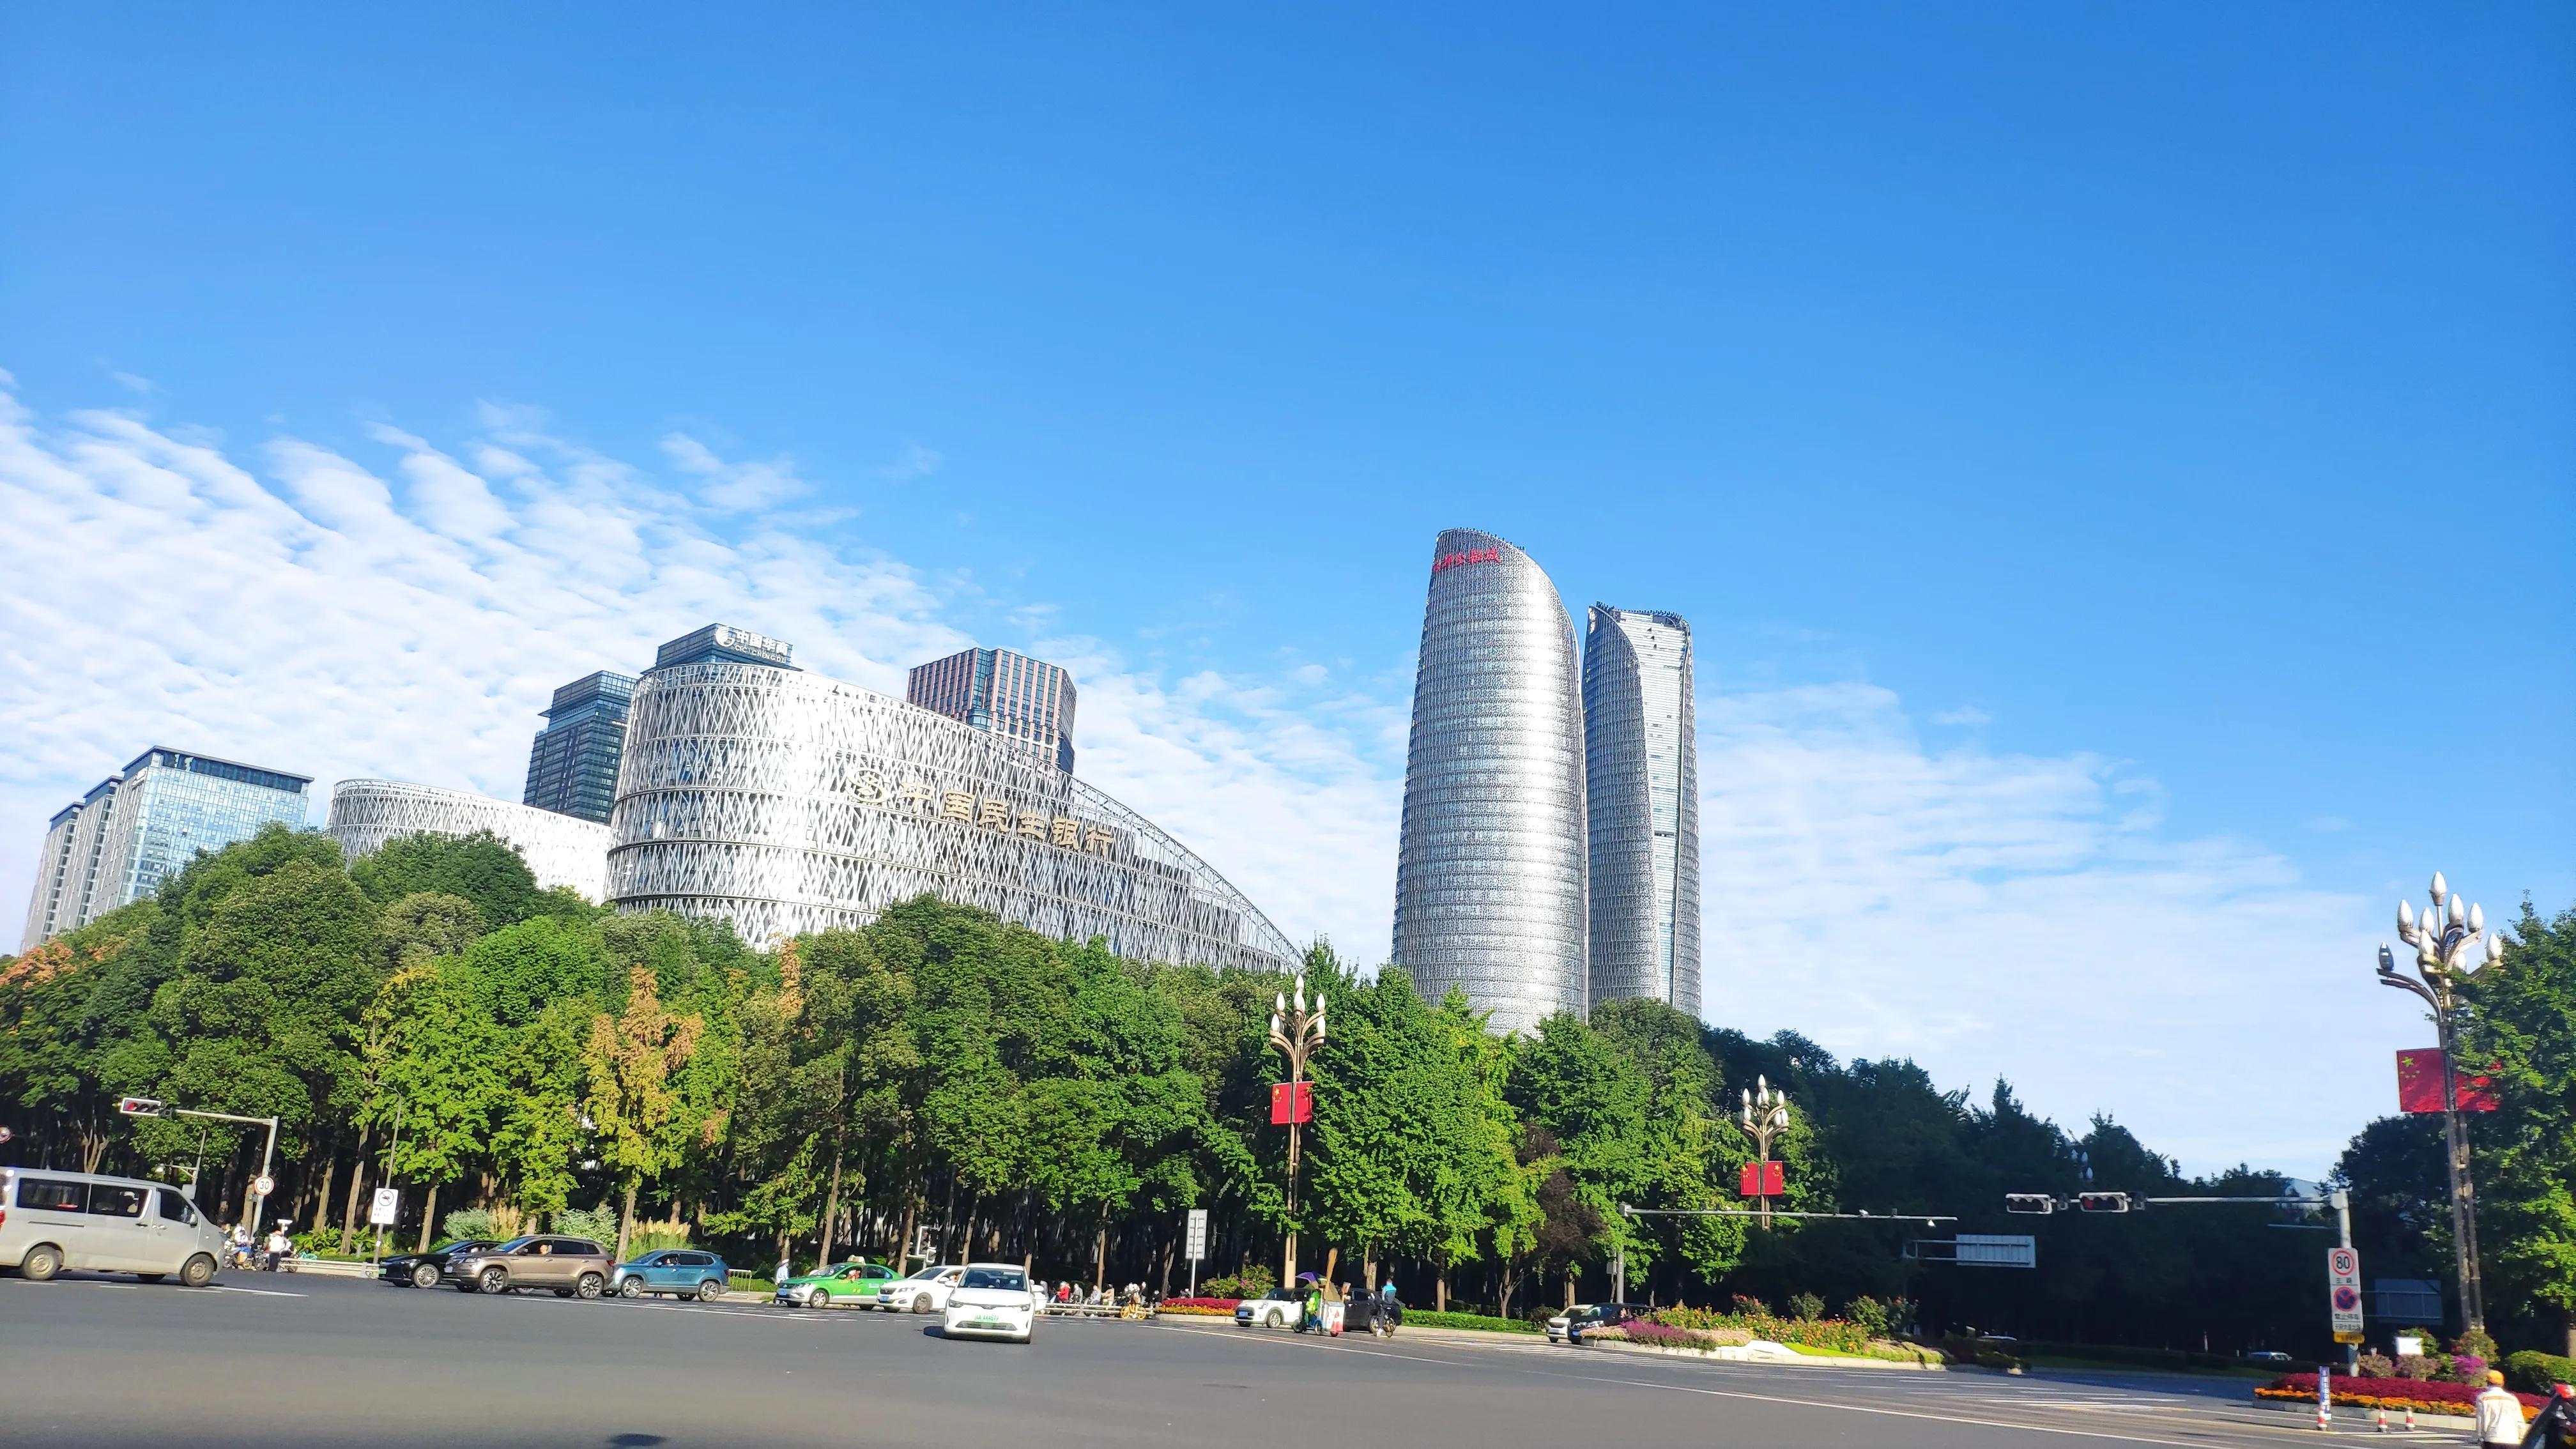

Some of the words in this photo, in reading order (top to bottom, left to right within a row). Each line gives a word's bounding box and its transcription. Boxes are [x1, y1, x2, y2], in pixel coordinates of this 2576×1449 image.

[736, 629, 789, 656] 中国华商
[751, 650, 786, 663] CHENGDU
[899, 781, 1114, 858] 中国民生银行
[259, 1181, 270, 1190] 30
[2336, 1256, 2350, 1269] 80
